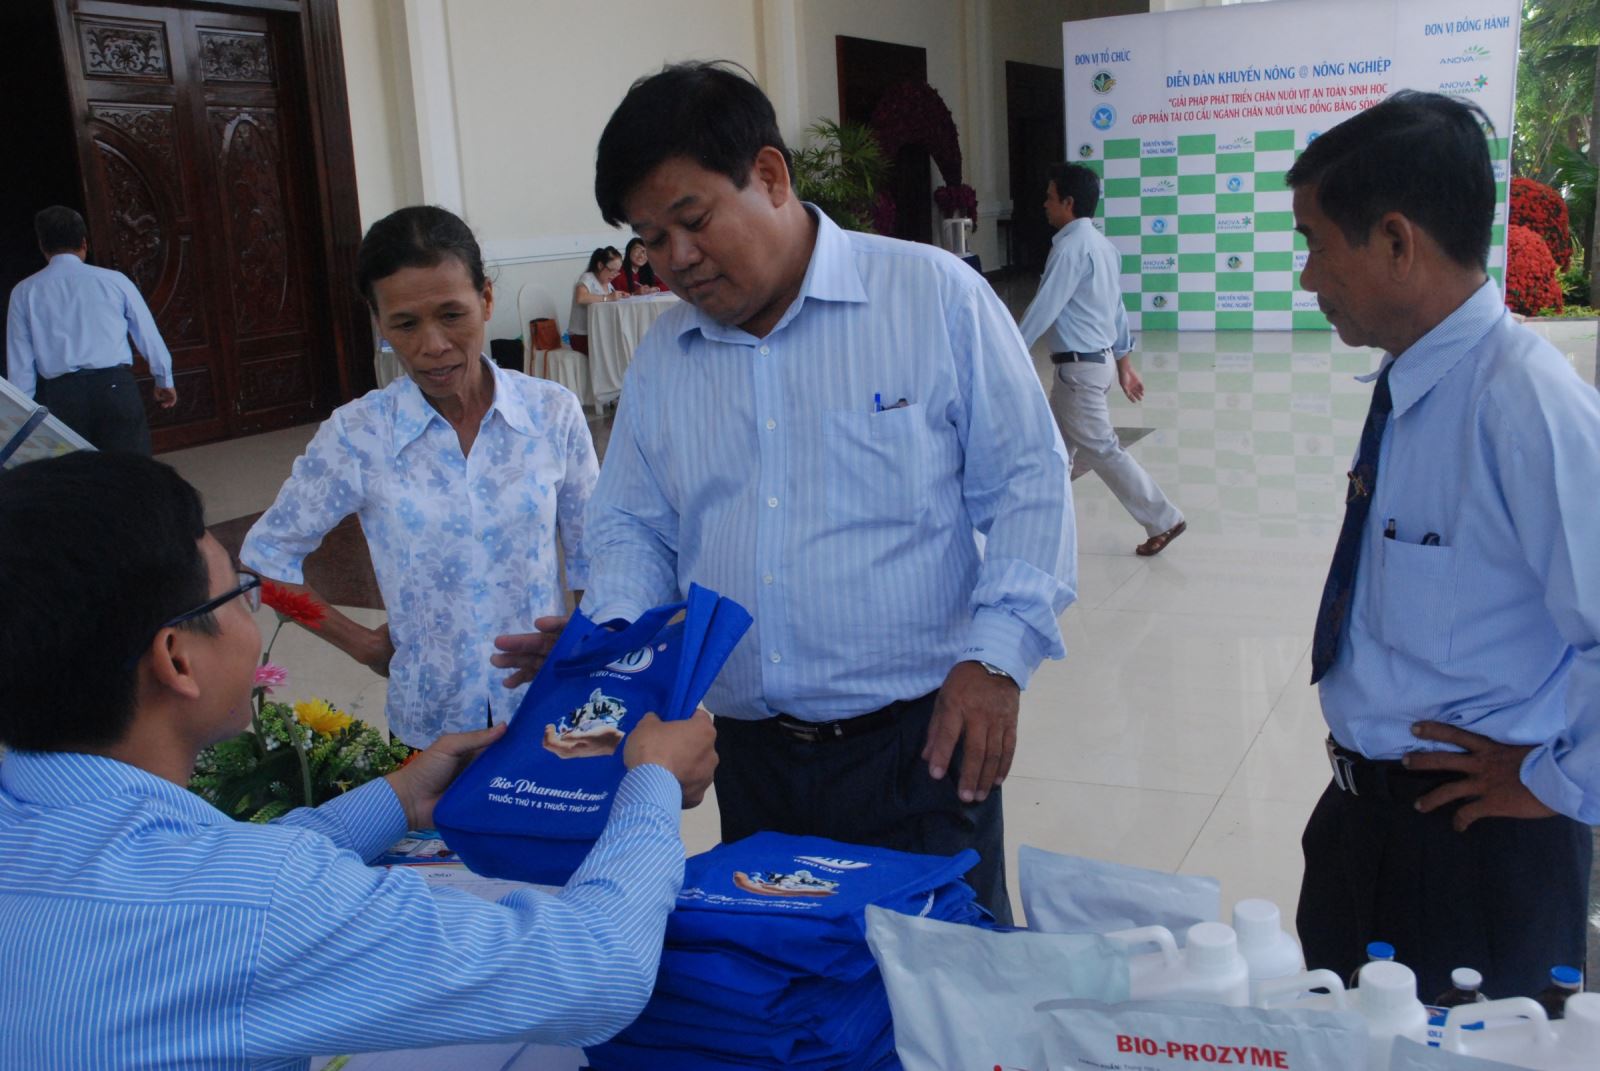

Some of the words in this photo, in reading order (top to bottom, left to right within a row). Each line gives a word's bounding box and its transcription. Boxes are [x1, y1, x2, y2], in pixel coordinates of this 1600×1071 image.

[1446, 22, 1454, 36] VỊ
[1456, 16, 1481, 33] ĐỒNG
[1092, 53, 1099, 65] VỊ
[1439, 55, 1474, 65] ANOVA
[1166, 70, 1190, 88] DIỄN
[1193, 70, 1215, 86] ĐÀN
[1218, 64, 1261, 84] KHUYẾN
[1264, 65, 1295, 81] NÔNG
[1312, 61, 1345, 77] NÔNG
[1348, 56, 1392, 75] NGHIỆP
[1188, 94, 1209, 106] PHÁP
[1210, 92, 1230, 105] PHÁT
[1231, 88, 1252, 103] TRIỂN
[1278, 88, 1297, 100] NUÔI
[1298, 88, 1310, 101] VỊT
[1312, 87, 1324, 98] AN
[1325, 84, 1346, 98] TOÀN
[1349, 84, 1367, 96] SINH
[1370, 82, 1388, 96] HỌC
[1439, 80, 1472, 89] ANOVA
[1196, 106, 1212, 120] CẤU
[1265, 103, 1285, 116] NUÔI
[1309, 99, 1332, 114] ĐỒNG
[1359, 98, 1380, 110] SÔN
[488, 793, 514, 805] THUỐC
[531, 800, 536, 808] Y
[544, 801, 568, 812] THUỐC
[1116, 1034, 1290, 1070] BIO-PROZYME
